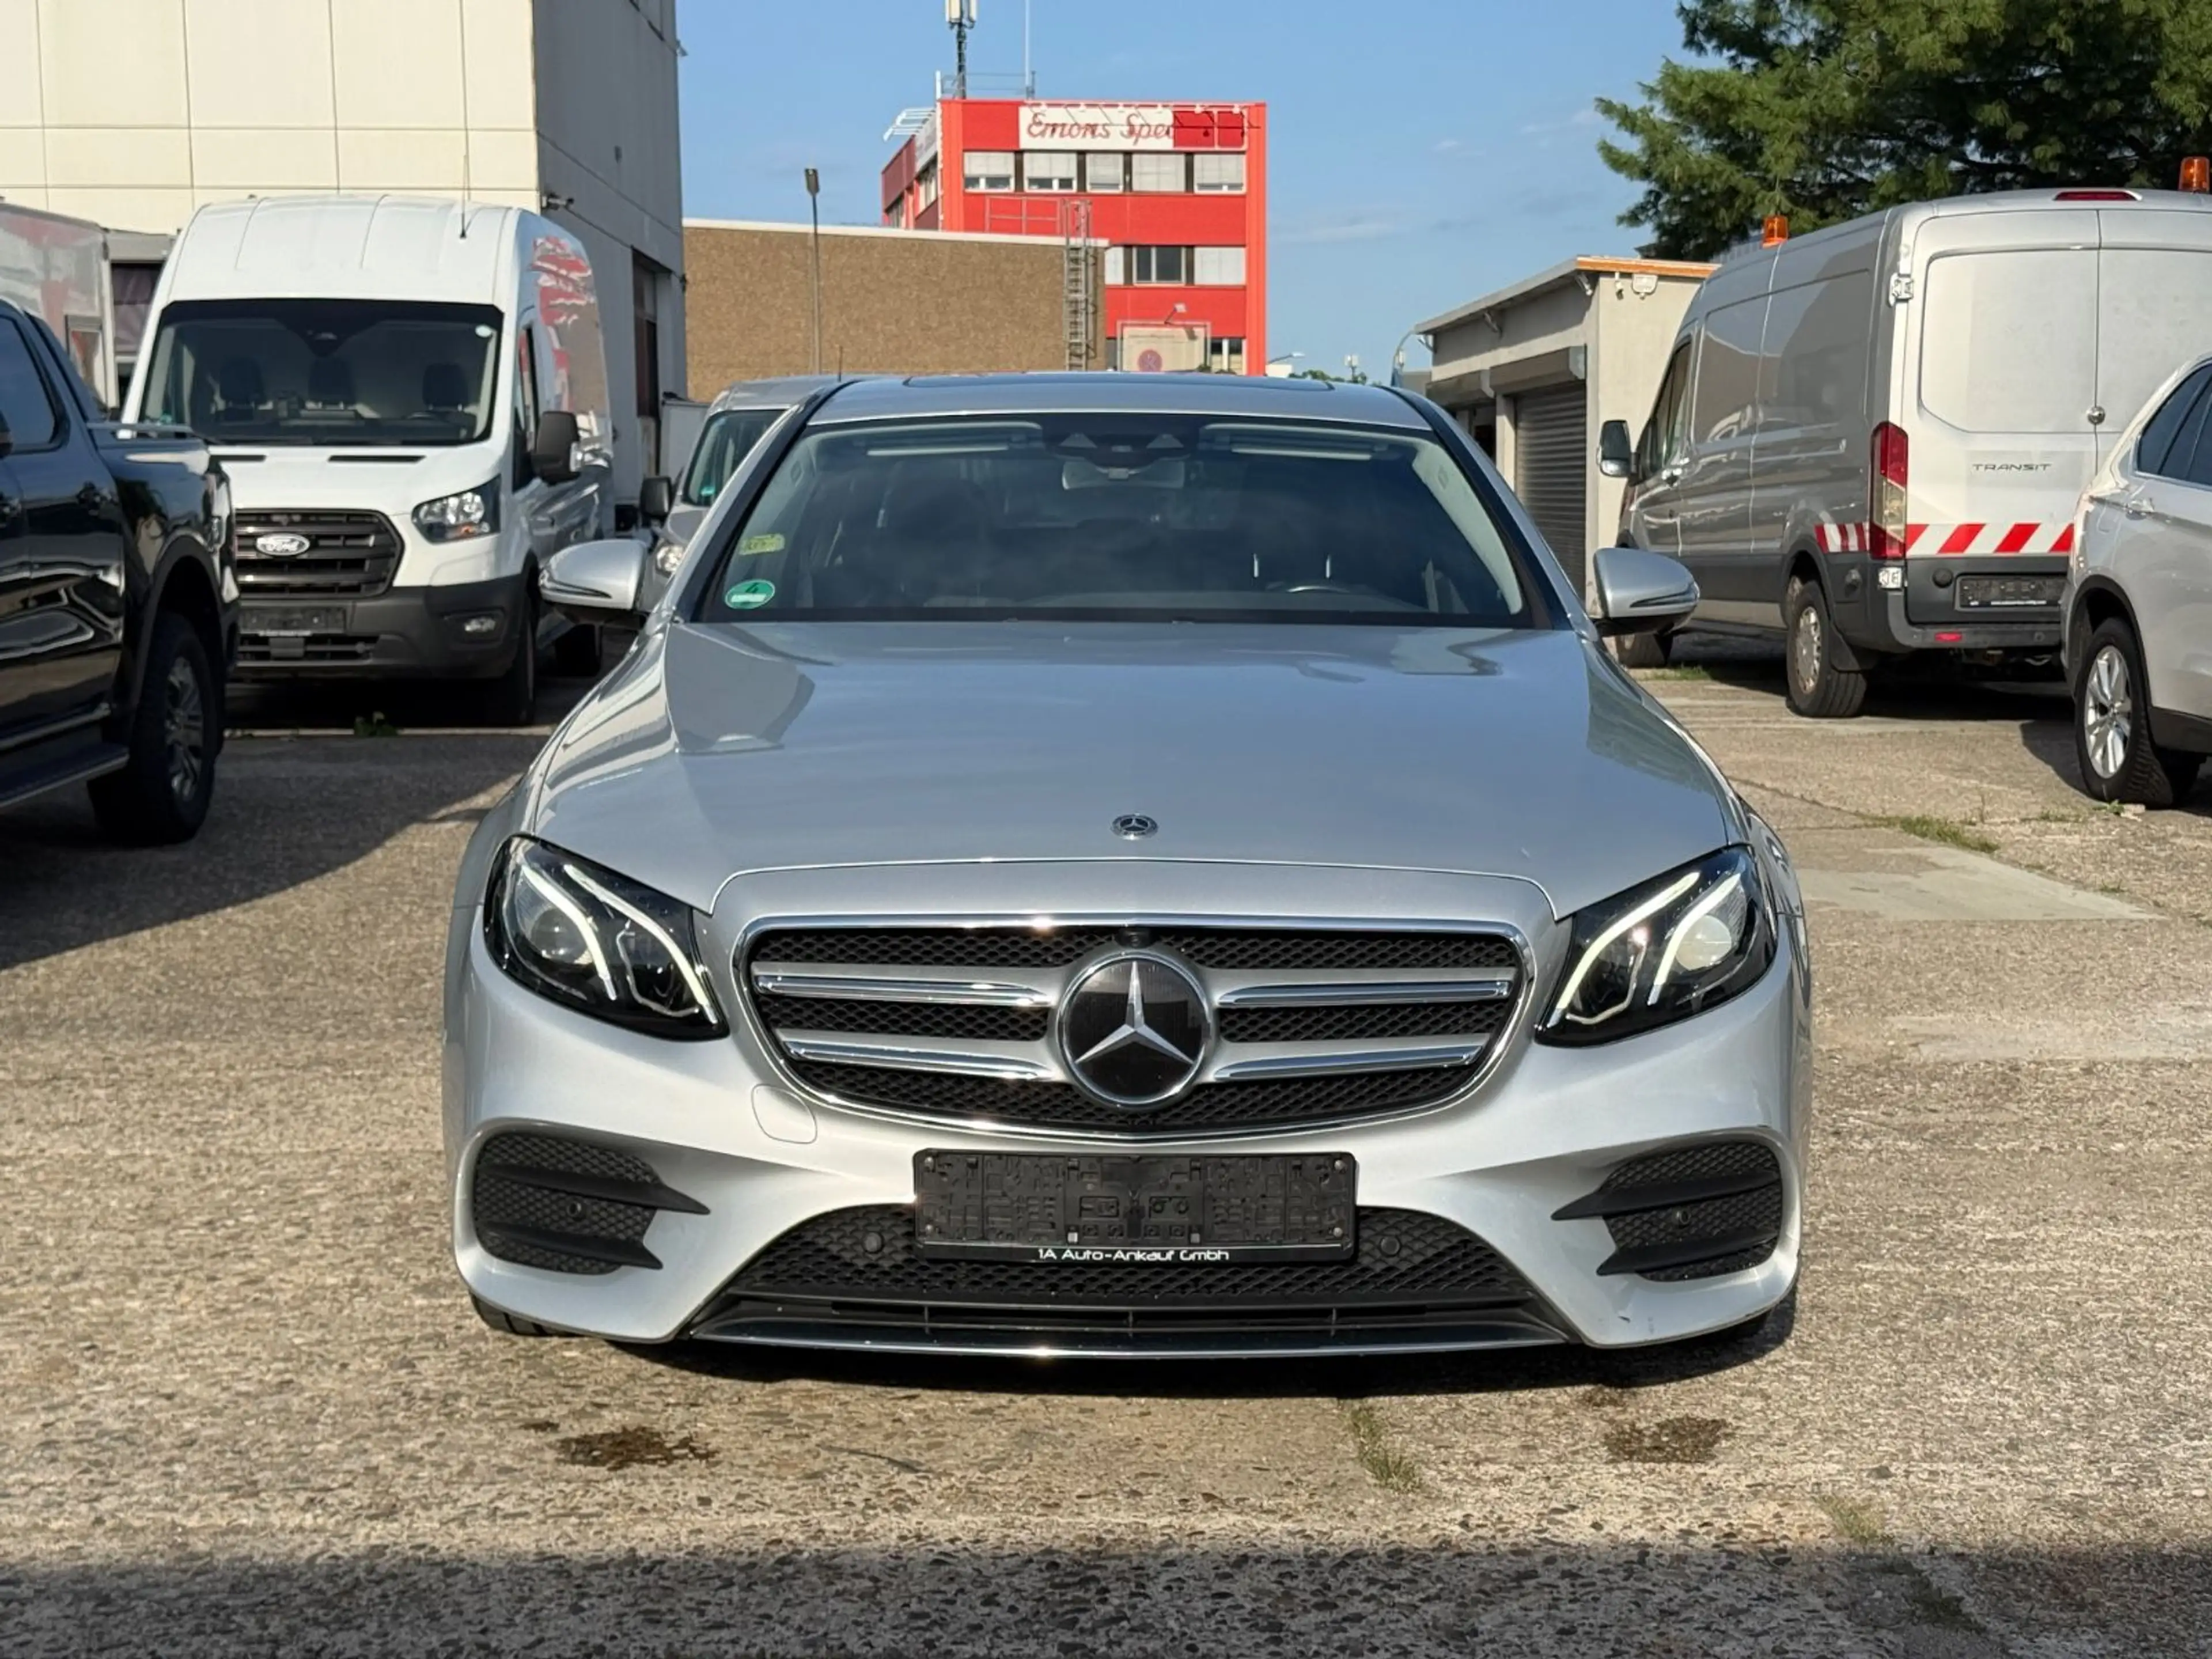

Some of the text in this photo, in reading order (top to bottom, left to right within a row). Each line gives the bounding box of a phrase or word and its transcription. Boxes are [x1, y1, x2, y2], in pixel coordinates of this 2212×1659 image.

[1028, 112, 1111, 139] Emons
[1972, 463, 2052, 471] TRANSIT
[1038, 1248, 1057, 1260] 1A
[1061, 1248, 1175, 1261] Auto-Ankauf
